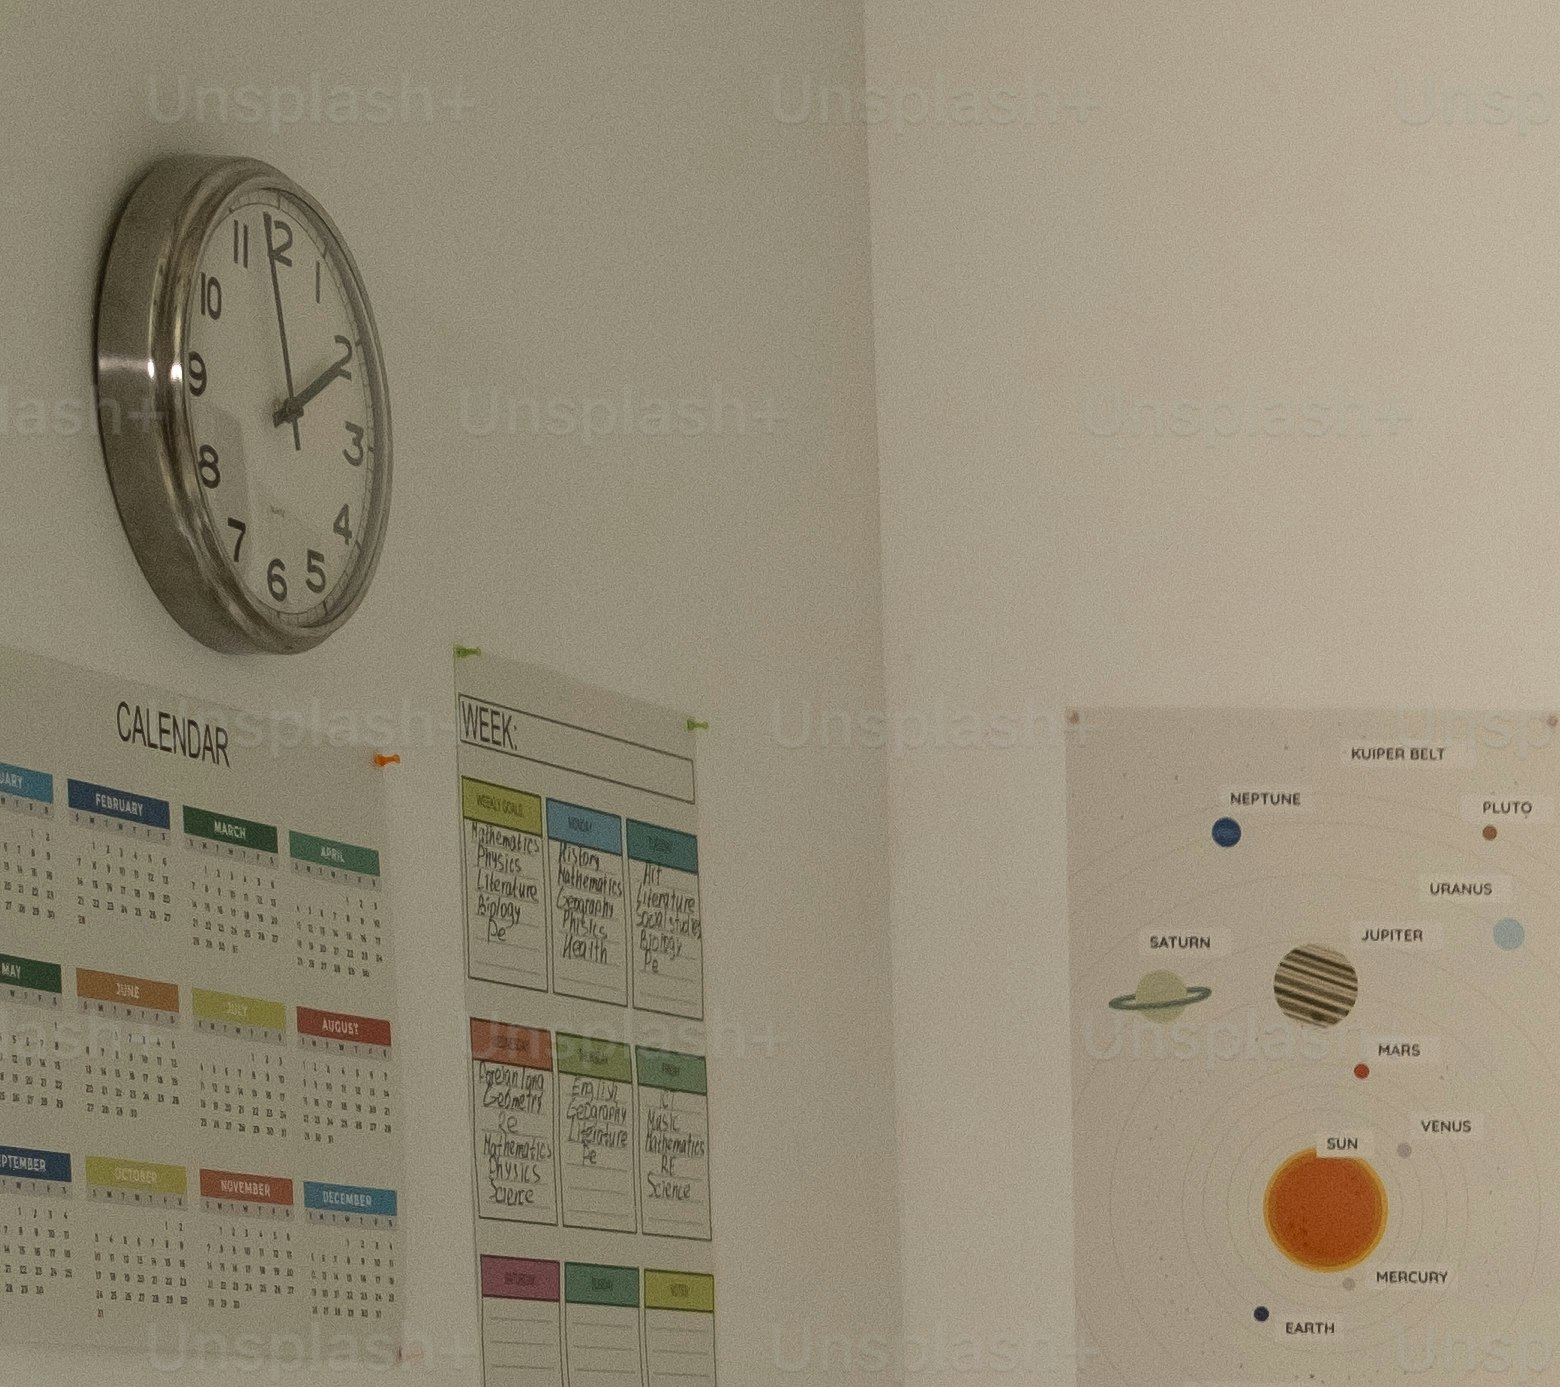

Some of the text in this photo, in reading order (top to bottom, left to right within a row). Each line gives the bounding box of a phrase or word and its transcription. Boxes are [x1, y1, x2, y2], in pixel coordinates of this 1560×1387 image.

[199, 271, 223, 321] 10
[332, 334, 354, 381] 2
[188, 350, 208, 397] 9
[341, 420, 366, 468] 3
[199, 443, 222, 490] 8
[332, 502, 353, 547] 4
[226, 517, 248, 564] 7
[265, 557, 289, 601] 6
[304, 549, 328, 595] 5
[116, 700, 231, 768] CALENDAR
[461, 701, 518, 751] WEEK:
[1351, 746, 1446, 761] KUIPER BELT
[1229, 792, 1302, 807] NEPTUNE
[1481, 801, 1533, 815] PLUTO
[95, 793, 346, 864] FEBRUARY MARCH APRIL
[1428, 882, 1494, 896] URANUS
[1149, 935, 1212, 950] SATURN
[1361, 928, 1424, 943] JUPITER
[1, 961, 22, 979] MAY
[321, 1018, 360, 1037] AUGUST
[1377, 1043, 1422, 1058] MARS
[1420, 1119, 1473, 1134] VENUS
[1326, 1137, 1359, 1151] SUN
[220, 1179, 271, 1198] NOVEMBER
[322, 1189, 372, 1208] DECEMBER
[1375, 1270, 1449, 1285] MERCURY
[1284, 1321, 1336, 1336] EARTH
